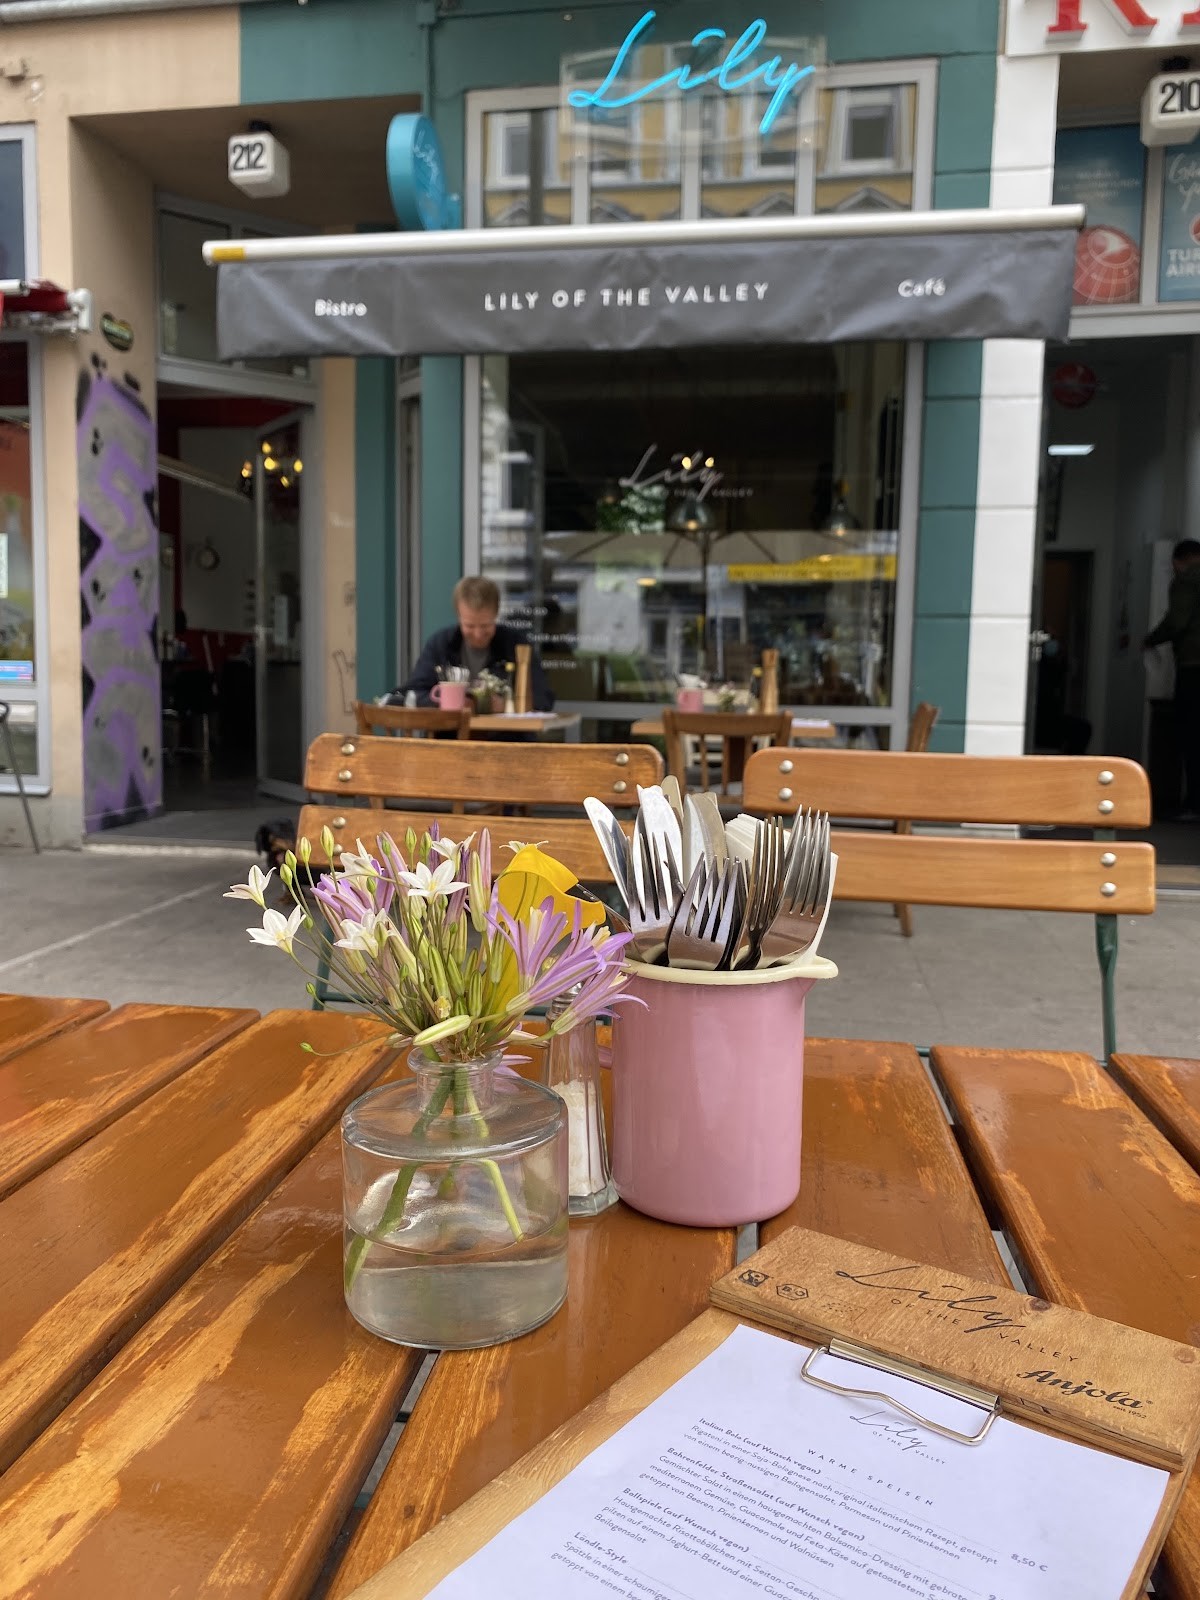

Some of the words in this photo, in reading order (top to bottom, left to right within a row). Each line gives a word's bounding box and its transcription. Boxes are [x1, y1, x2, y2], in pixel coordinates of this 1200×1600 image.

[567, 9, 816, 134] Lily
[1160, 79, 1200, 114] 210
[232, 142, 265, 171] 212
[314, 298, 368, 317] Bistro
[484, 291, 539, 312] LILY
[552, 288, 587, 309] OF
[600, 287, 651, 307] THE
[664, 282, 769, 304] VALLEY
[897, 276, 946, 298] Café
[618, 442, 725, 502] Lily
[835, 1265, 1027, 1334] Lily
[891, 1298, 915, 1308] OF
[927, 1309, 961, 1326] THE
[999, 1332, 1079, 1362] VALLEY
[1016, 1370, 1143, 1409] Anjola
[849, 1410, 928, 1451] Lily
[887, 1437, 902, 1446] THE
[915, 1449, 946, 1465] VALLEY
[667, 1448, 719, 1474] Bahrenfelder
[720, 1472, 773, 1499] Straßensalat
[775, 1497, 798, 1511] (auf
[797, 1506, 830, 1526] Wunsch
[834, 1525, 865, 1541] vegan)
[692, 1425, 724, 1443] Rigatoni
[732, 1445, 752, 1456] einer
[750, 1452, 813, 1483] Soja-Bolognese
[812, 1481, 832, 1491] nach
[834, 1491, 867, 1507] original
[867, 1503, 922, 1531] italienischem
[925, 1528, 958, 1548] Rezept,
[960, 1547, 997, 1564] getoppt
[698, 1441, 720, 1452] einem
[781, 1476, 835, 1505] Beilagensalat,
[839, 1502, 880, 1524] Parmesan
[883, 1523, 901, 1532] und
[902, 1530, 960, 1559] Pinienkernen
[699, 1418, 723, 1432] Italian
[743, 1438, 762, 1447] (auf
[762, 1445, 791, 1462] Wunsch
[794, 1461, 821, 1474] vegan)
[1011, 1554, 1035, 1567] 8,50
[808, 1448, 857, 1474] WARME
[867, 1475, 934, 1506] SPEISEN
[574, 1532, 626, 1563] Ländle-Style
[594, 1514, 646, 1543] Beilagensalat
[602, 1507, 625, 1519] pilzen
[627, 1518, 644, 1529] auf
[642, 1525, 668, 1541] einem
[666, 1538, 723, 1569] Joghurt-Bett
[722, 1565, 741, 1578] und
[740, 1575, 762, 1587] einer
[614, 1496, 673, 1530] Hausgemachte
[672, 1525, 735, 1560] Risottobällchen
[737, 1559, 754, 1570] mit
[623, 1488, 664, 1512] Ballspiele
[663, 1508, 685, 1522] (auf
[684, 1517, 716, 1537] Wunsch
[719, 1536, 749, 1552] vegan)
[639, 1473, 670, 1488] getoppt
[672, 1487, 684, 1495] von
[686, 1493, 714, 1511] Beeren,
[717, 1508, 769, 1536] Pinienkernen
[771, 1535, 788, 1544] und
[790, 1542, 834, 1567] Walnüssen
[650, 1465, 701, 1491] mediterranem
[704, 1489, 736, 1509] Gemüse,
[739, 1506, 785, 1530] Guacamole
[787, 1529, 805, 1541] und
[803, 1534, 848, 1561] Feta-Käse
[851, 1560, 869, 1573] auf
[865, 1564, 925, 1597] getoastetem
[660, 1456, 703, 1480] Gemischter
[702, 1476, 724, 1490] Salat
[722, 1485, 734, 1495] in
[733, 1492, 756, 1504] einem
[758, 1501, 822, 1535] hausgemachten
[824, 1532, 911, 1578] Balsamico-Dressing
[913, 1575, 931, 1589] mit
[551, 1553, 584, 1571] getoppt
[585, 1570, 601, 1582] von
[600, 1579, 627, 1597] einem
[563, 1542, 594, 1563] Spätzle
[593, 1557, 603, 1568] in
[602, 1565, 623, 1576] einer
